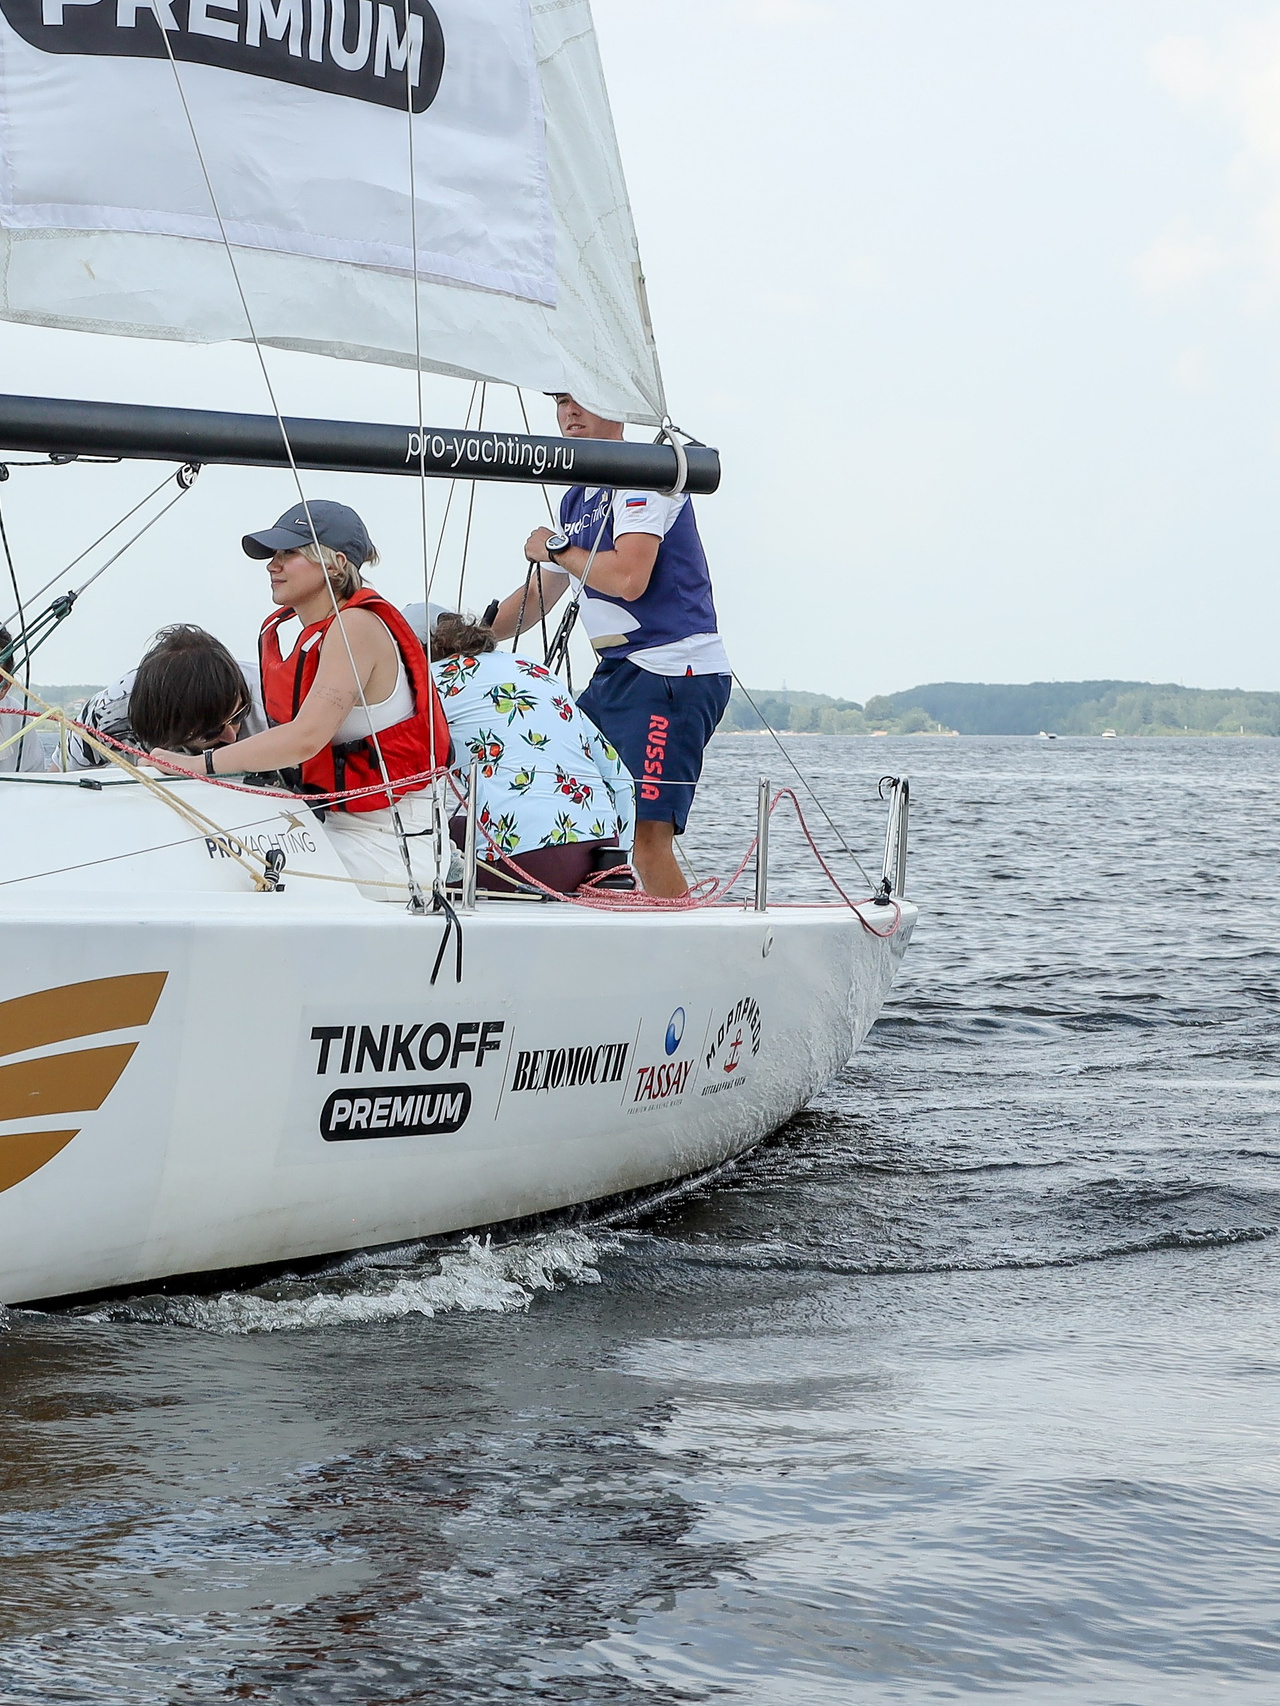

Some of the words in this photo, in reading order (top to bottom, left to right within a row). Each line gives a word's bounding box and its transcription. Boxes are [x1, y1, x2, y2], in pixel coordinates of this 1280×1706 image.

[405, 433, 575, 475] pro-yachting.ru
[641, 714, 669, 801] RUSSIA
[310, 1021, 505, 1075] TINKOFF
[706, 997, 761, 1070] МОРПРИБОР
[511, 1042, 630, 1096] ВЕДОМОСТИ
[634, 1059, 694, 1102] TASSAY
[329, 1092, 464, 1132] PREMIUM
